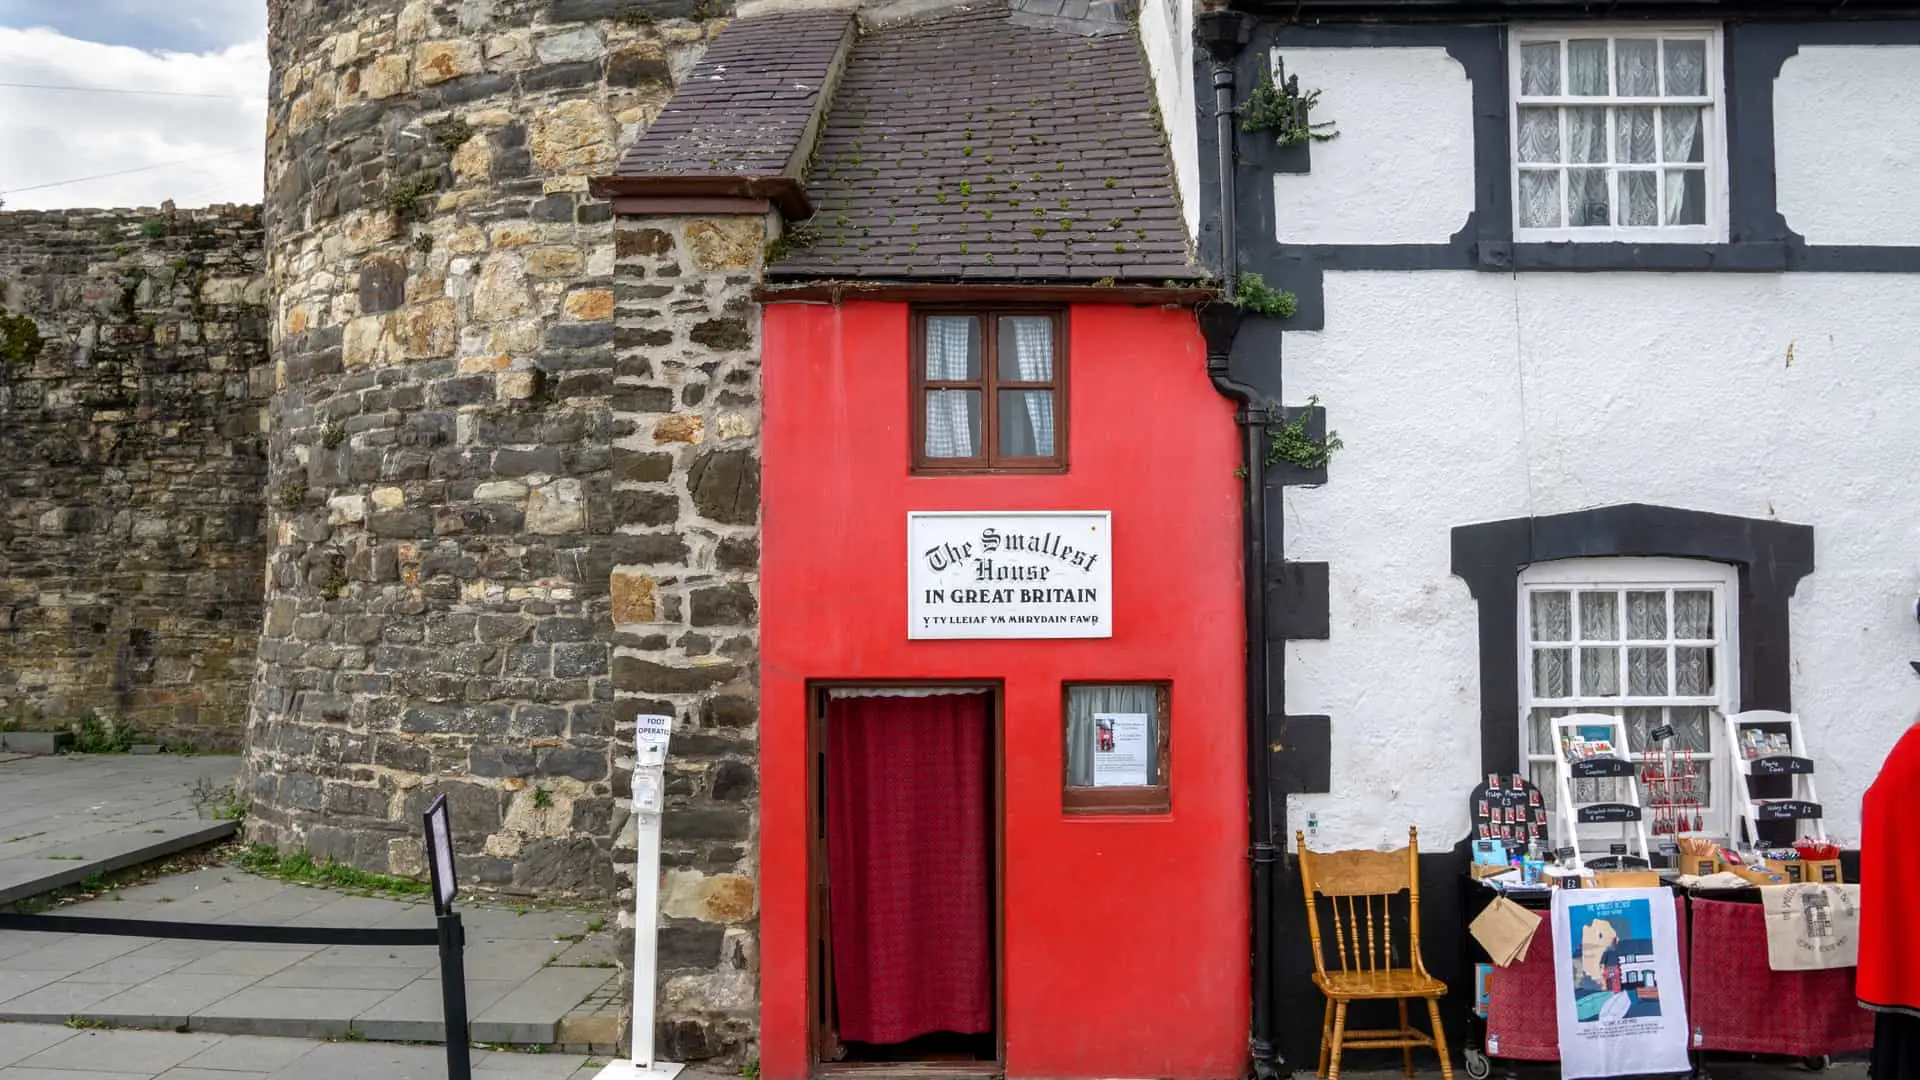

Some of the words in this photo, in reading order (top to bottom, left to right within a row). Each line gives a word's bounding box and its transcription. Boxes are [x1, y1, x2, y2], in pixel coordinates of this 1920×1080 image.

[925, 540, 973, 572] The
[981, 527, 1098, 573] Smallest
[974, 558, 1050, 581] House
[925, 589, 945, 604] IN
[950, 588, 1015, 604] GREAT
[1020, 588, 1097, 603] BRITAIN
[923, 616, 930, 629] Y
[932, 616, 947, 624] TY
[949, 616, 987, 624] LLEIAF
[989, 615, 1006, 624] YM
[1008, 615, 1067, 624] MHRYDAIN
[1070, 615, 1099, 626] FAWR
